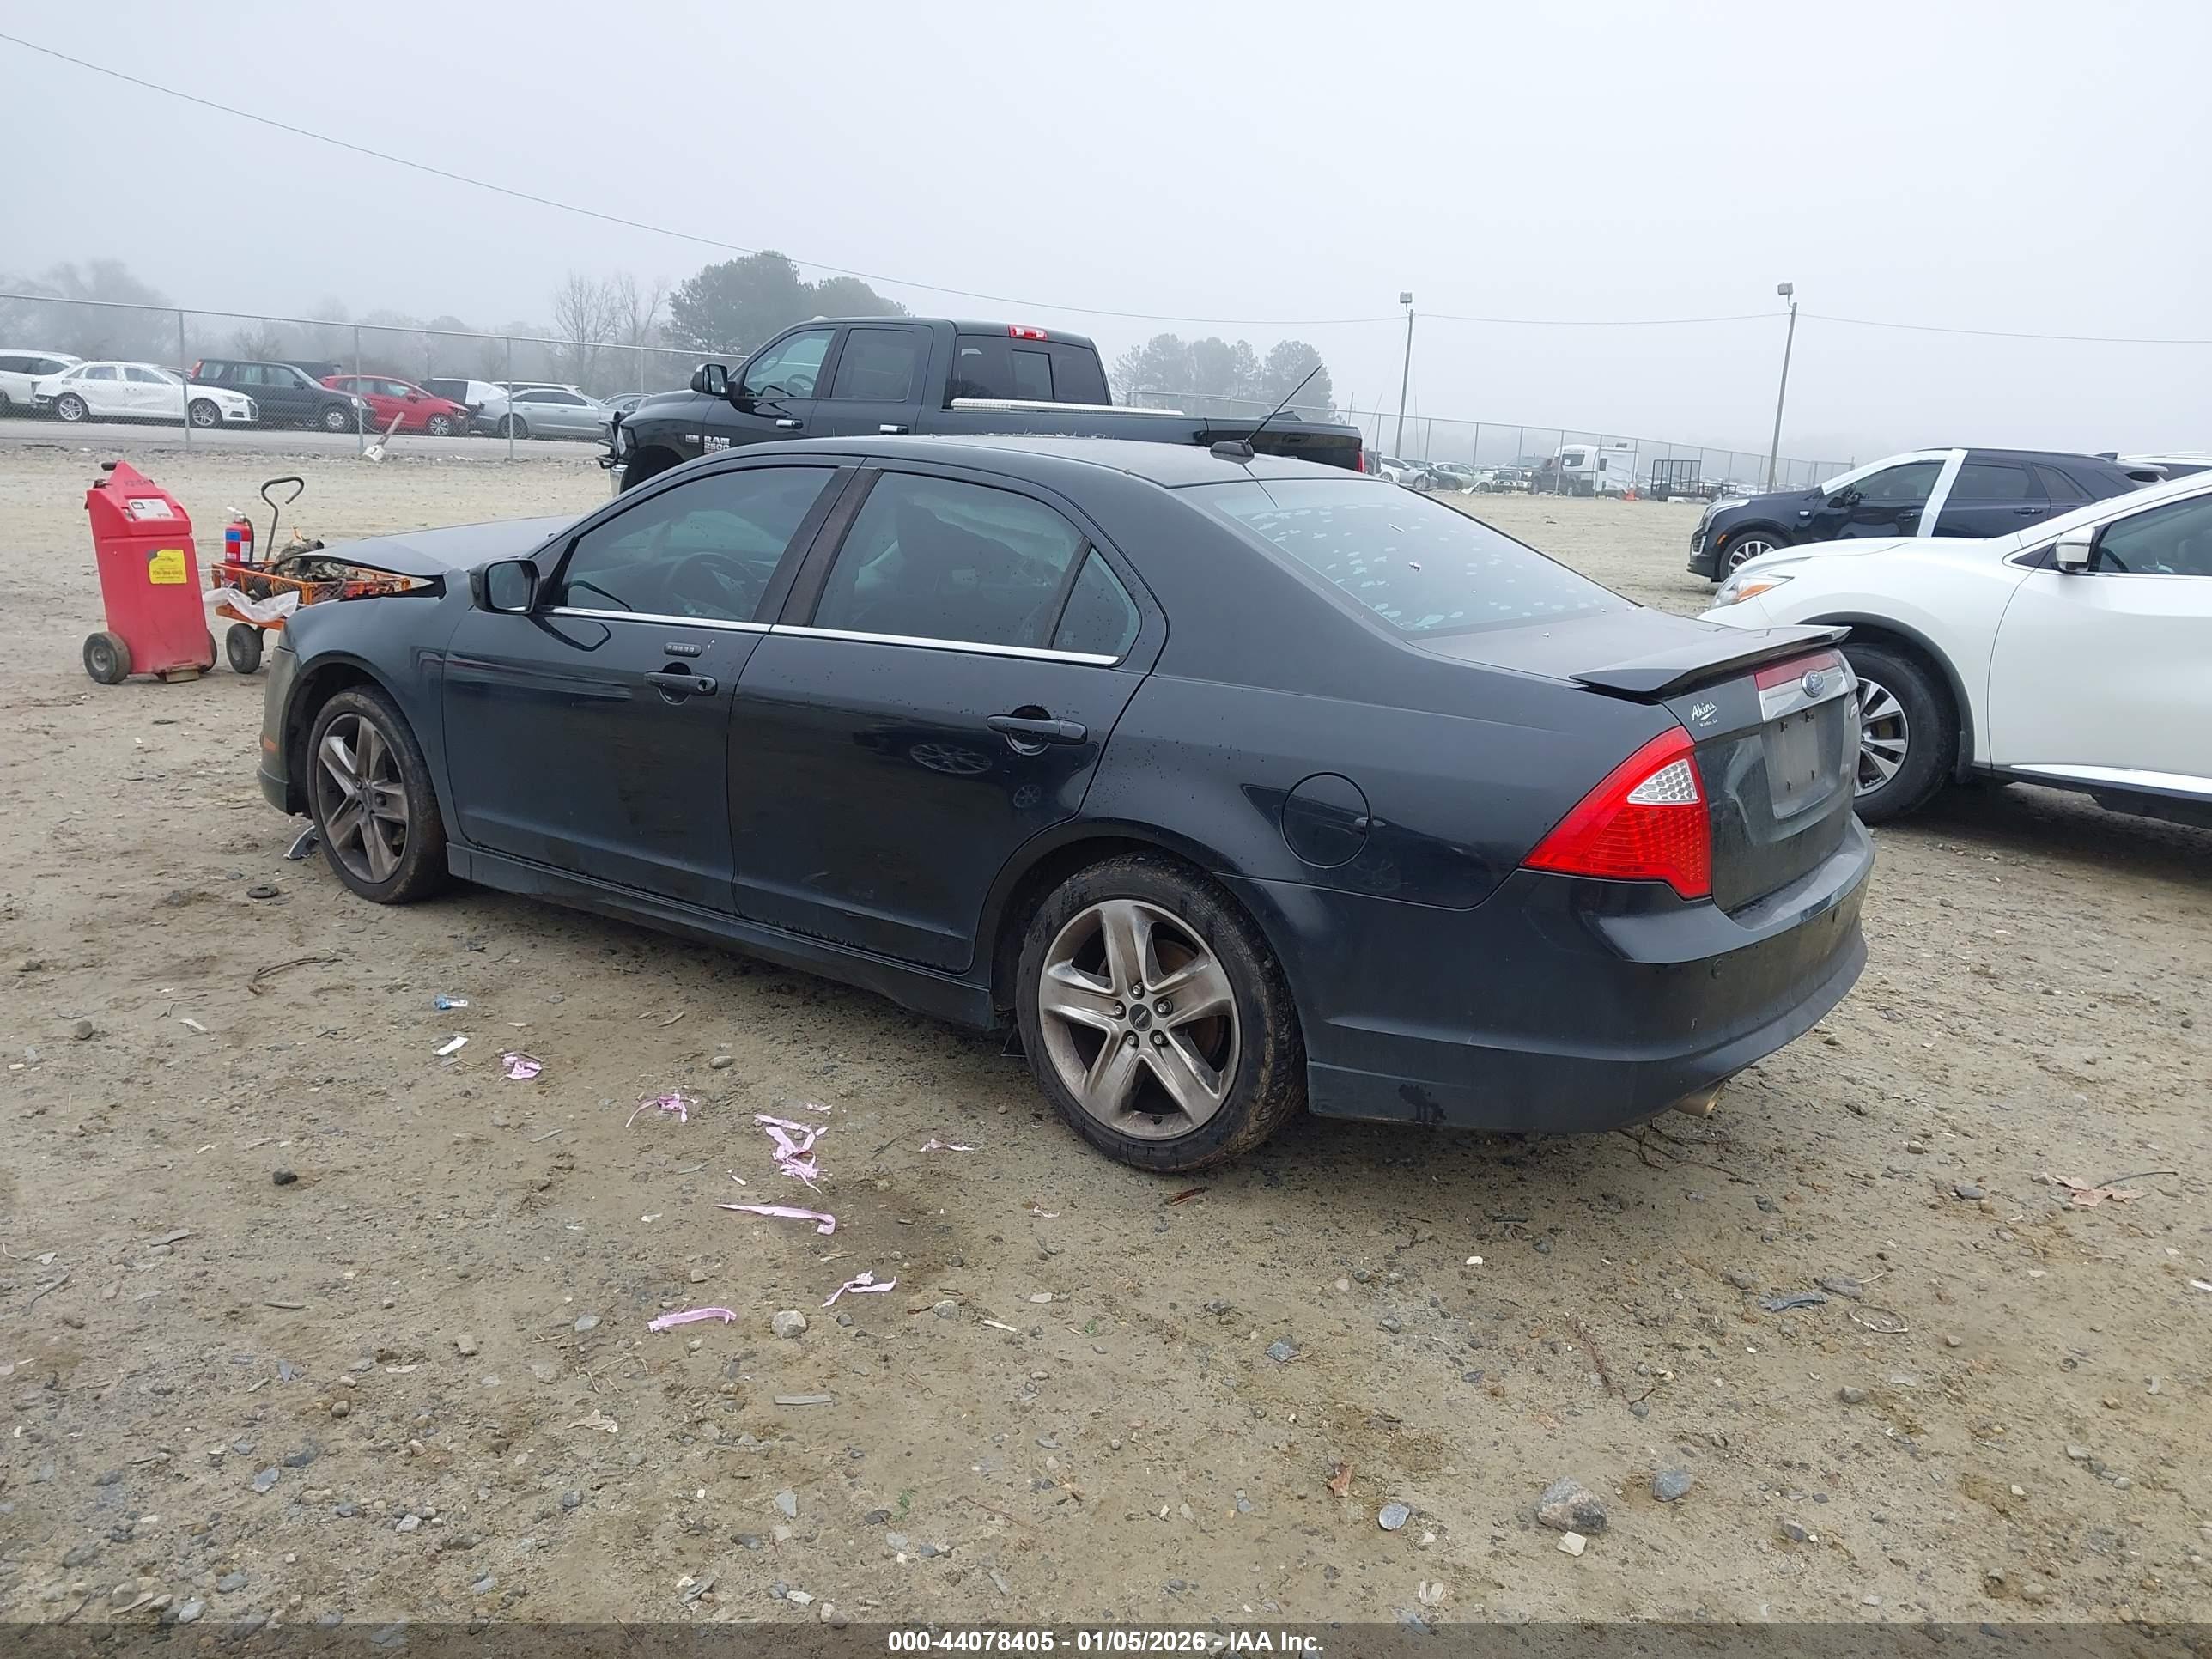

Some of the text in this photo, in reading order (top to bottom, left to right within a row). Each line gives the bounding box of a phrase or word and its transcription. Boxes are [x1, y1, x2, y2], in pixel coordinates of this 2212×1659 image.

[704, 435, 730, 445] RAM
[704, 442, 730, 451] 2500
[1692, 701, 1717, 720] Akins
